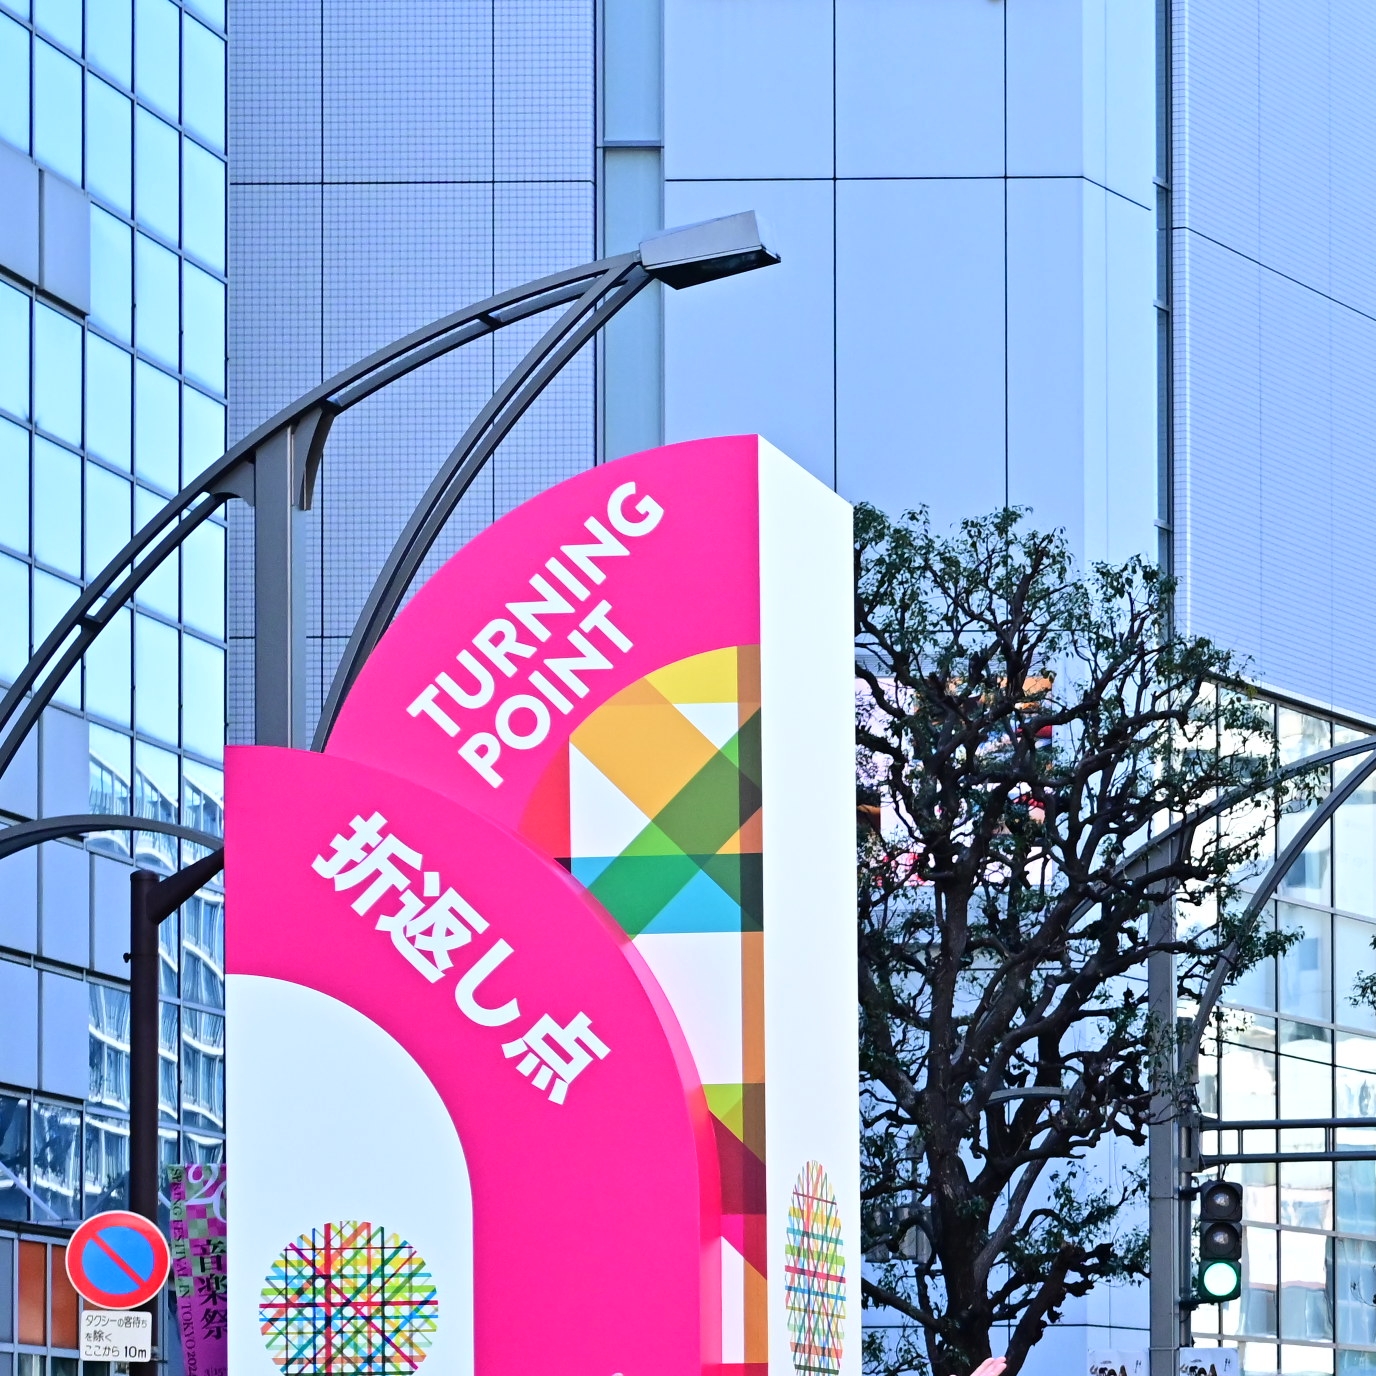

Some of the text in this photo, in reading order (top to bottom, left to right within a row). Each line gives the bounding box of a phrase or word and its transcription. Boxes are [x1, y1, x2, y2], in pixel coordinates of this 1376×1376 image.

[408, 482, 664, 736] TURNING
[458, 601, 634, 789] POINT
[311, 811, 611, 1105] 折返し点
[85, 1315, 148, 1329] タクシーの客待ち
[171, 1168, 187, 1216] SPRING
[181, 1303, 196, 1350] TOKYO
[199, 1238, 227, 1341] 音楽祭
[85, 1330, 113, 1342] を除く
[85, 1345, 147, 1358] ここから 10m
